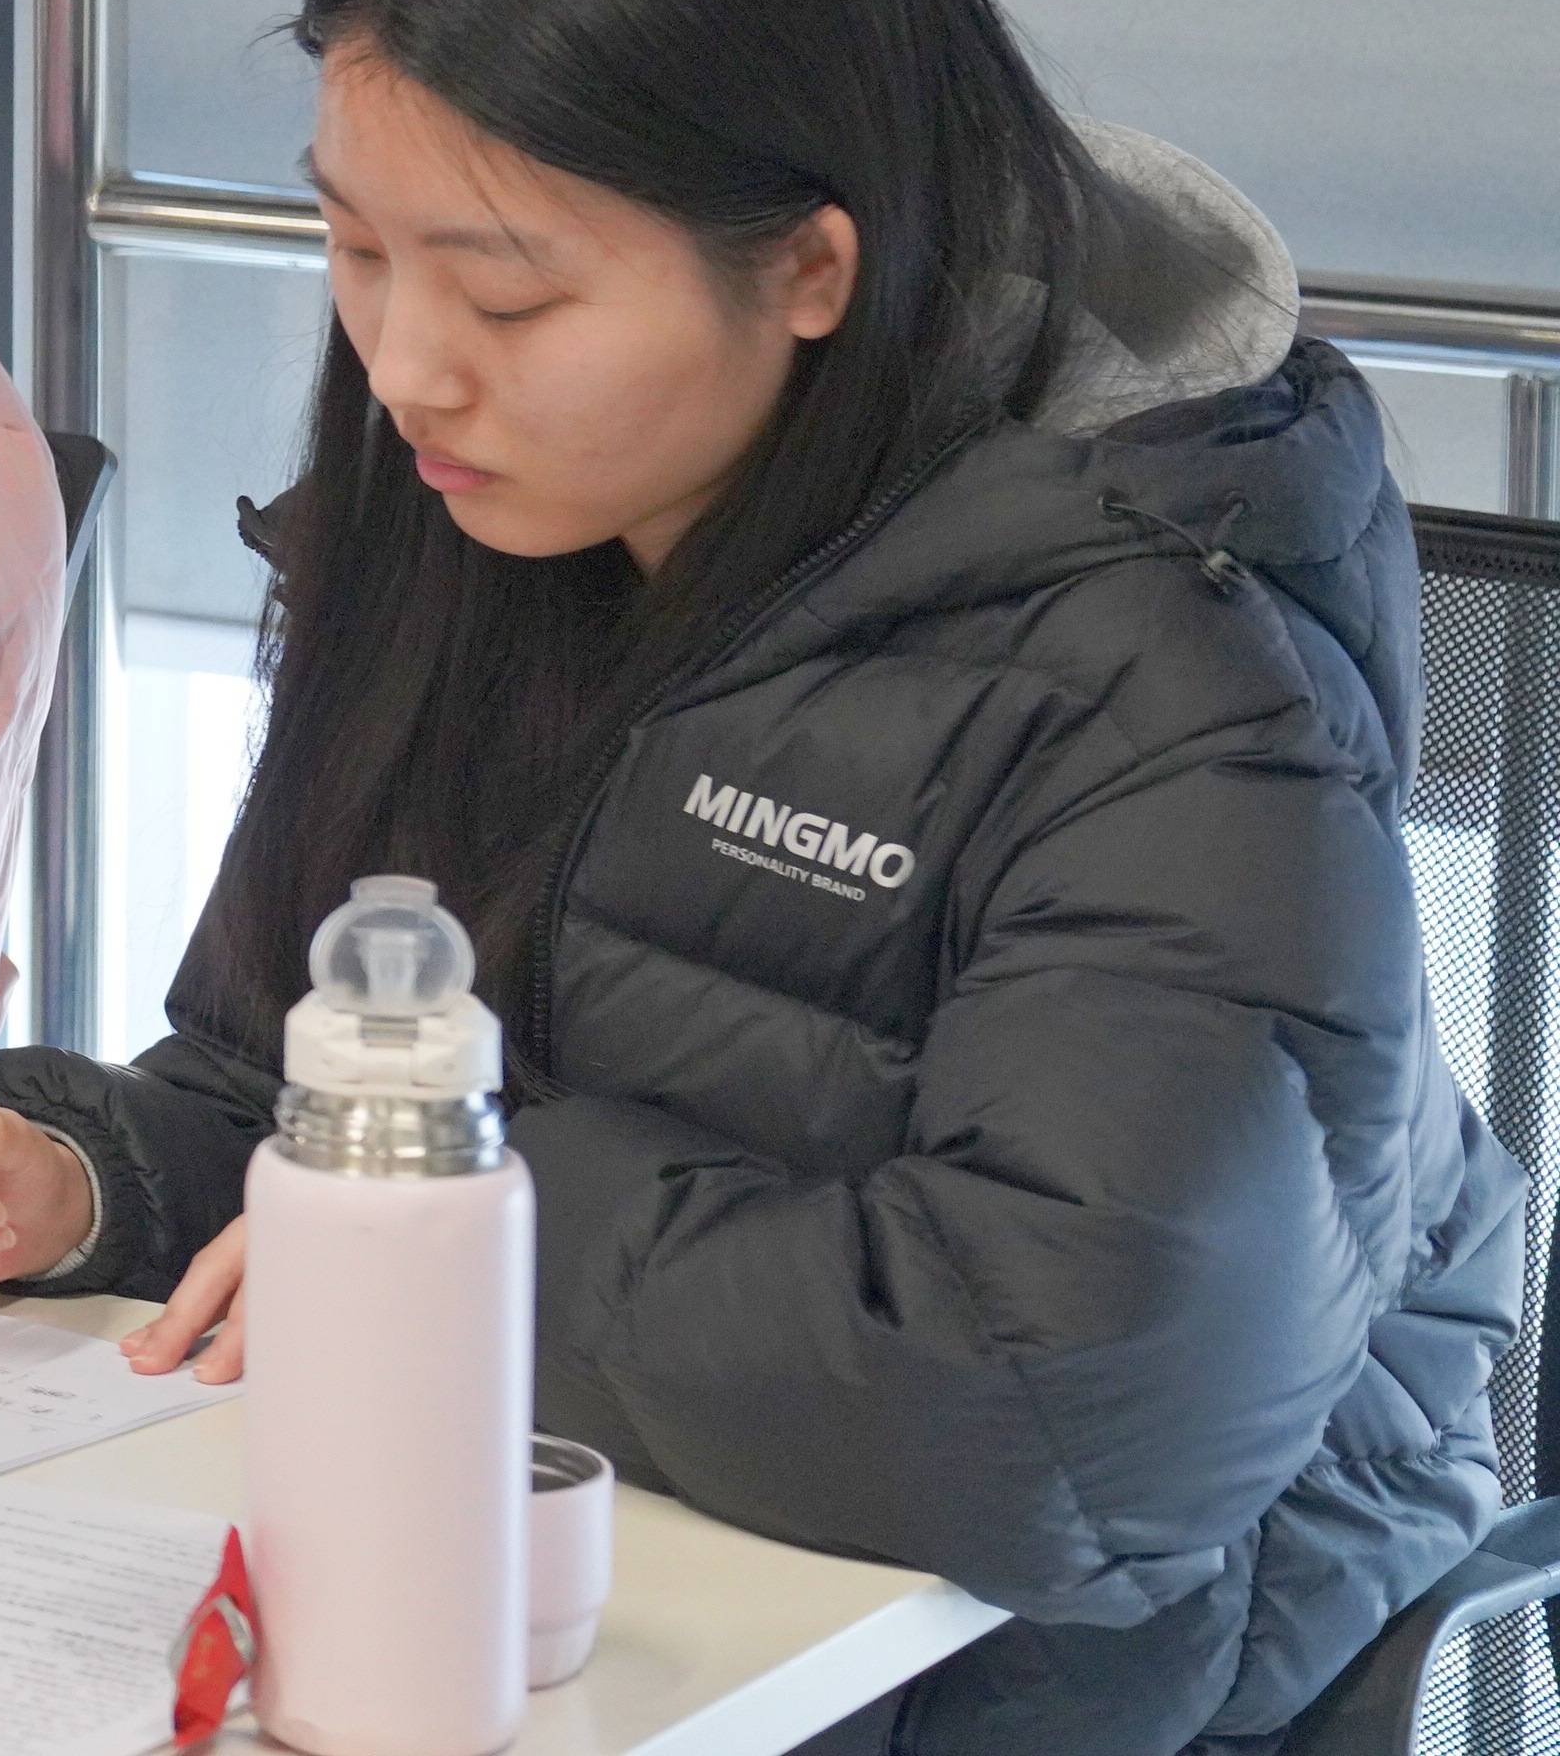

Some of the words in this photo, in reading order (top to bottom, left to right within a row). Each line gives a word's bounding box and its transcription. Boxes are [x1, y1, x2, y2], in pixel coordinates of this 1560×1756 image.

[683, 773, 916, 888] MINGMO
[711, 838, 810, 883] PERSONALITY
[811, 873, 866, 902] BRAND
